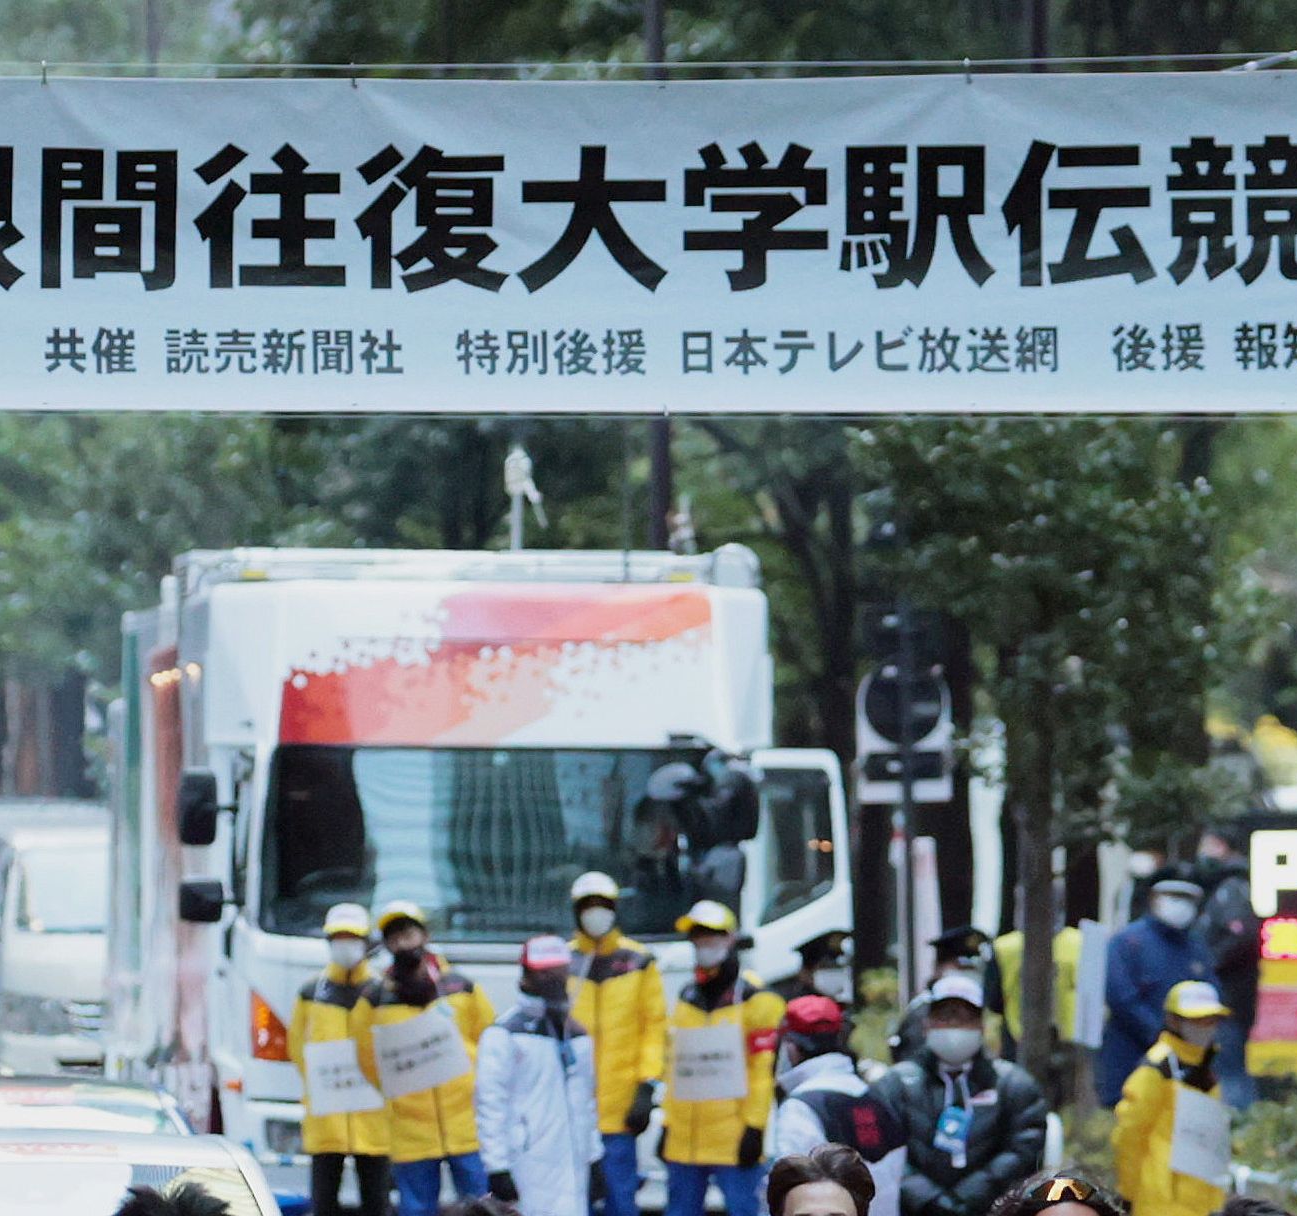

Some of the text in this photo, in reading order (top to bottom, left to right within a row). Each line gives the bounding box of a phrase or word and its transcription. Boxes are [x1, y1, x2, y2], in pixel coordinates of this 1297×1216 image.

[46, 328, 135, 374] 共催
[165, 329, 403, 374] 読売新聞社
[457, 330, 646, 375] 特別後援
[683, 327, 1058, 374] 日本テレビ放送網
[1113, 324, 1205, 371] 後援
